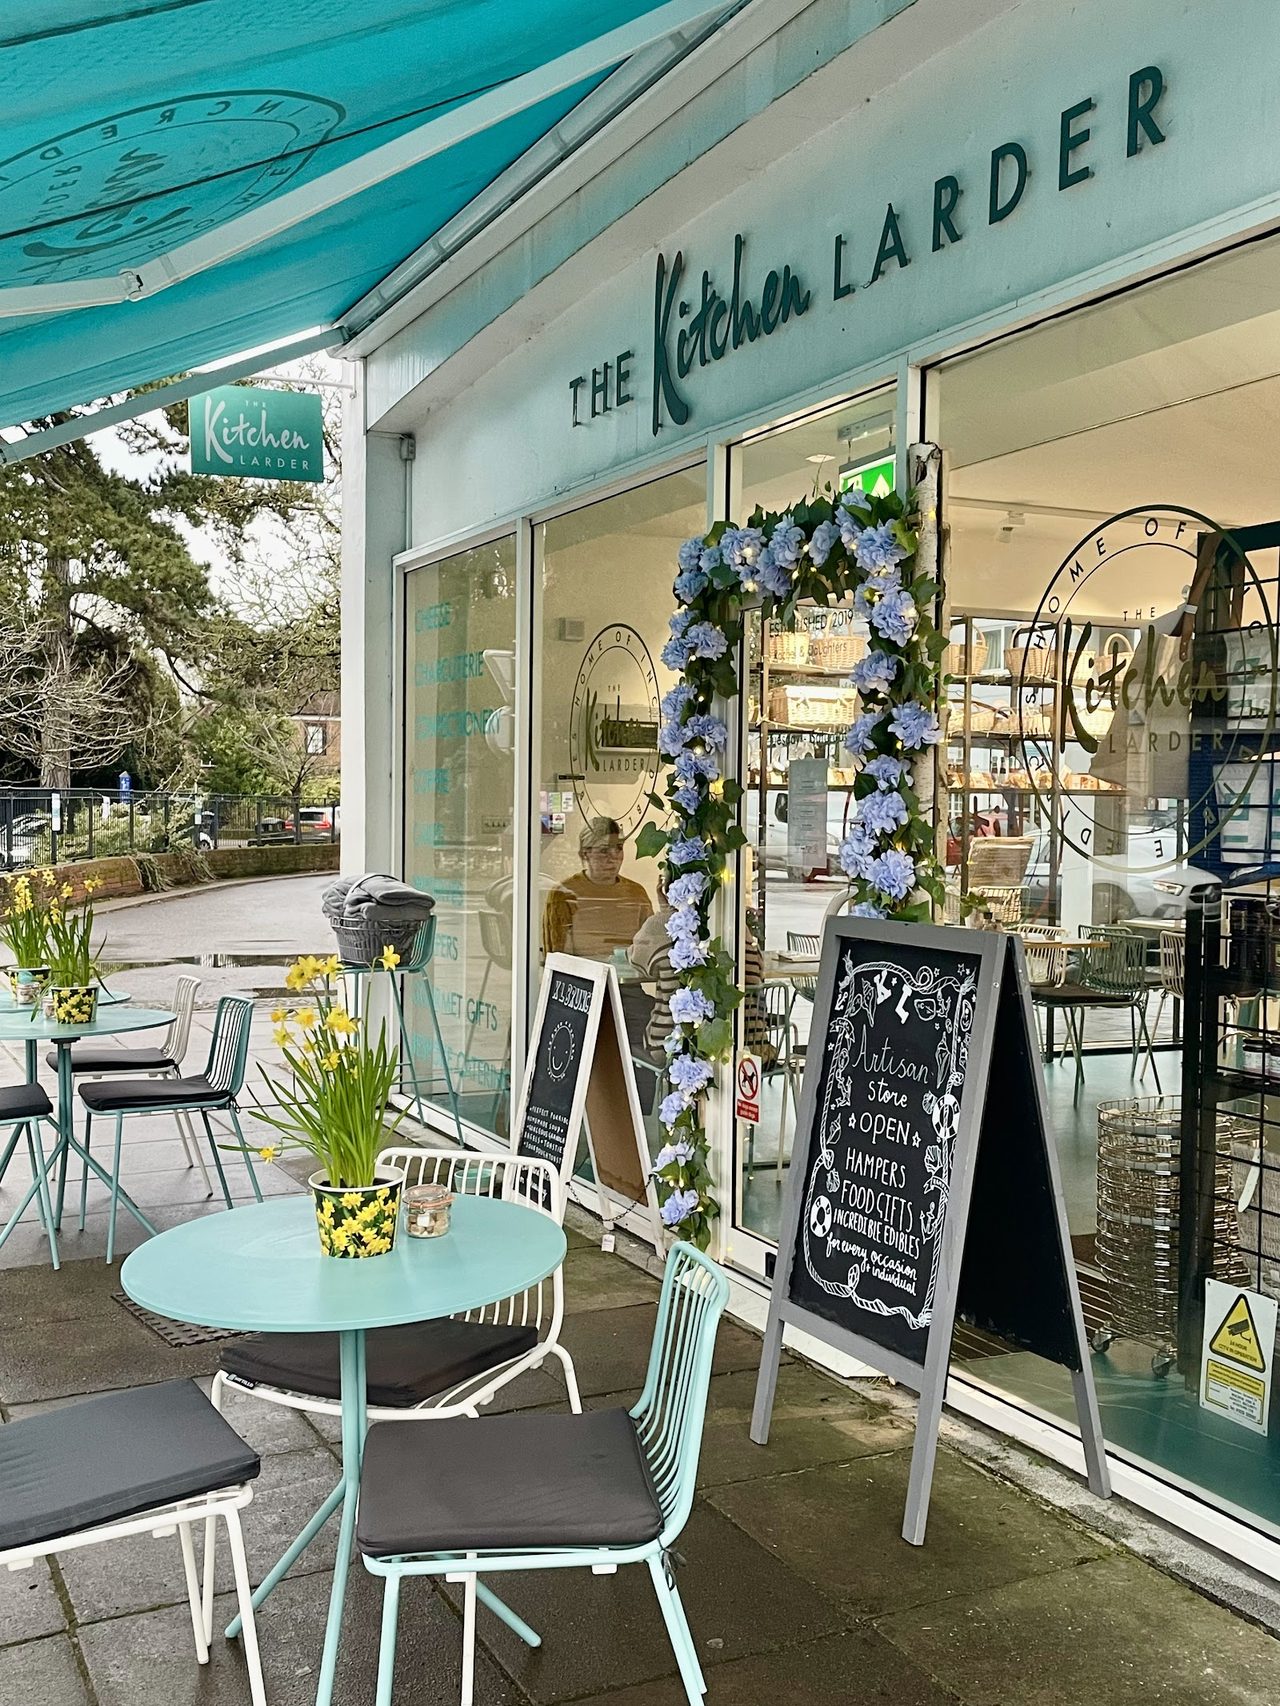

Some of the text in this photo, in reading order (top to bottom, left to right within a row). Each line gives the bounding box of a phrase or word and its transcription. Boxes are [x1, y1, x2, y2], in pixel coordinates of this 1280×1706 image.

[568, 64, 1167, 437] THE Kitchen LARDER
[245, 400, 267, 408] THE
[204, 395, 310, 464] Kitchen
[240, 455, 309, 471] LARDER
[1034, 537, 1107, 650] HOME
[1144, 517, 1187, 540] OF
[832, 608, 854, 628] 2019
[1123, 606, 1156, 622] THE
[574, 640, 603, 707] HOME
[615, 630, 631, 646] OF
[1059, 617, 1227, 754] Kitchen
[607, 684, 621, 692] THE
[1109, 728, 1224, 754] LARDER
[602, 758, 645, 772] LARDER
[466, 998, 498, 1031] GIFTS
[852, 1023, 929, 1085] Artisan
[867, 1077, 909, 1108] store
[859, 1112, 912, 1146] OPEN
[845, 1146, 906, 1189] HAMPERS
[840, 1179, 913, 1233] FOOD GIFTS
[833, 1208, 920, 1260] INCREDIBLE EDIBLES
[825, 1231, 918, 1281] for every occasion
